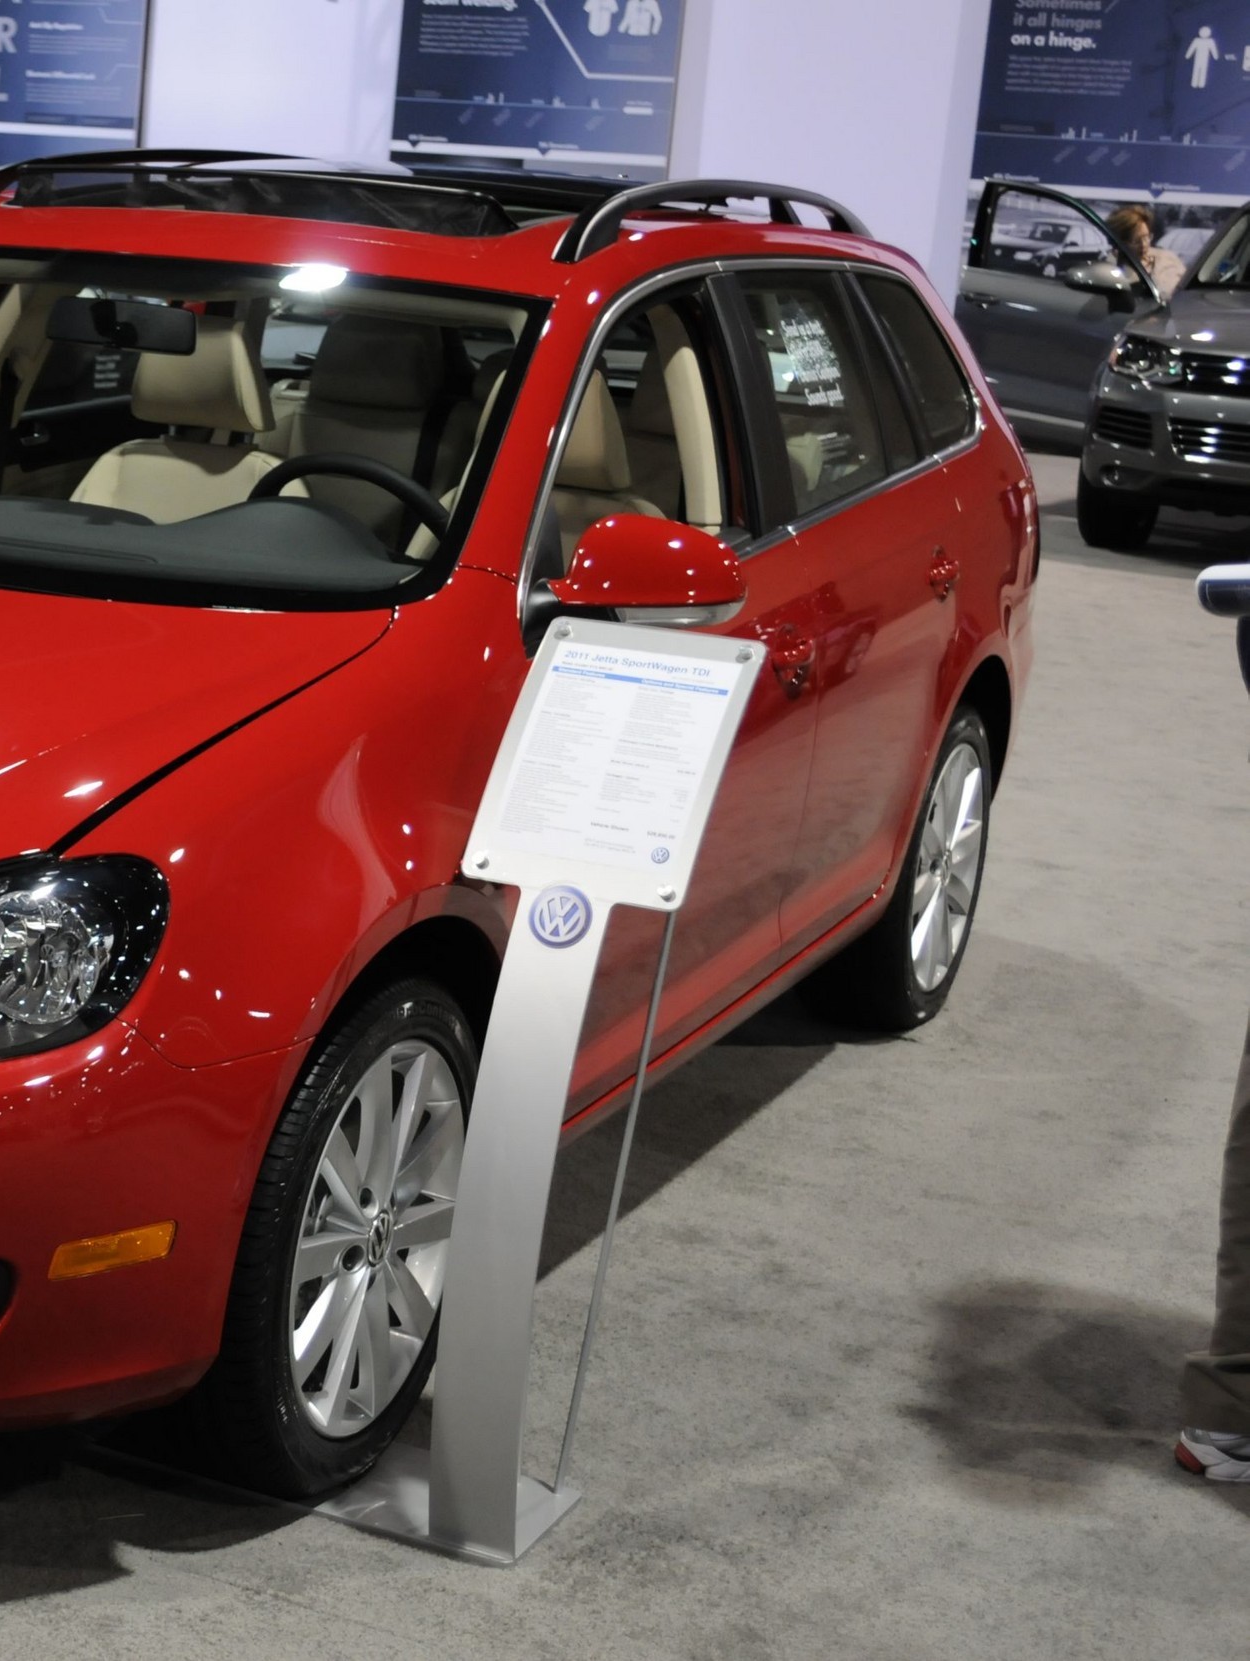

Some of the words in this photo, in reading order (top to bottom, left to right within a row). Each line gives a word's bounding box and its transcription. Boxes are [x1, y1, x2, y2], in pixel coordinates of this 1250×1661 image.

[1013, 12, 1024, 27] it
[1027, 11, 1047, 28] all
[1051, 12, 1102, 33] hinges
[1010, 34, 1031, 46] on
[1033, 35, 1046, 47] a
[1048, 30, 1096, 52] hinge.
[564, 650, 589, 661] 2011
[591, 652, 619, 665] Jetta
[621, 657, 688, 675] SportWagen
[691, 667, 711, 678] TDI
